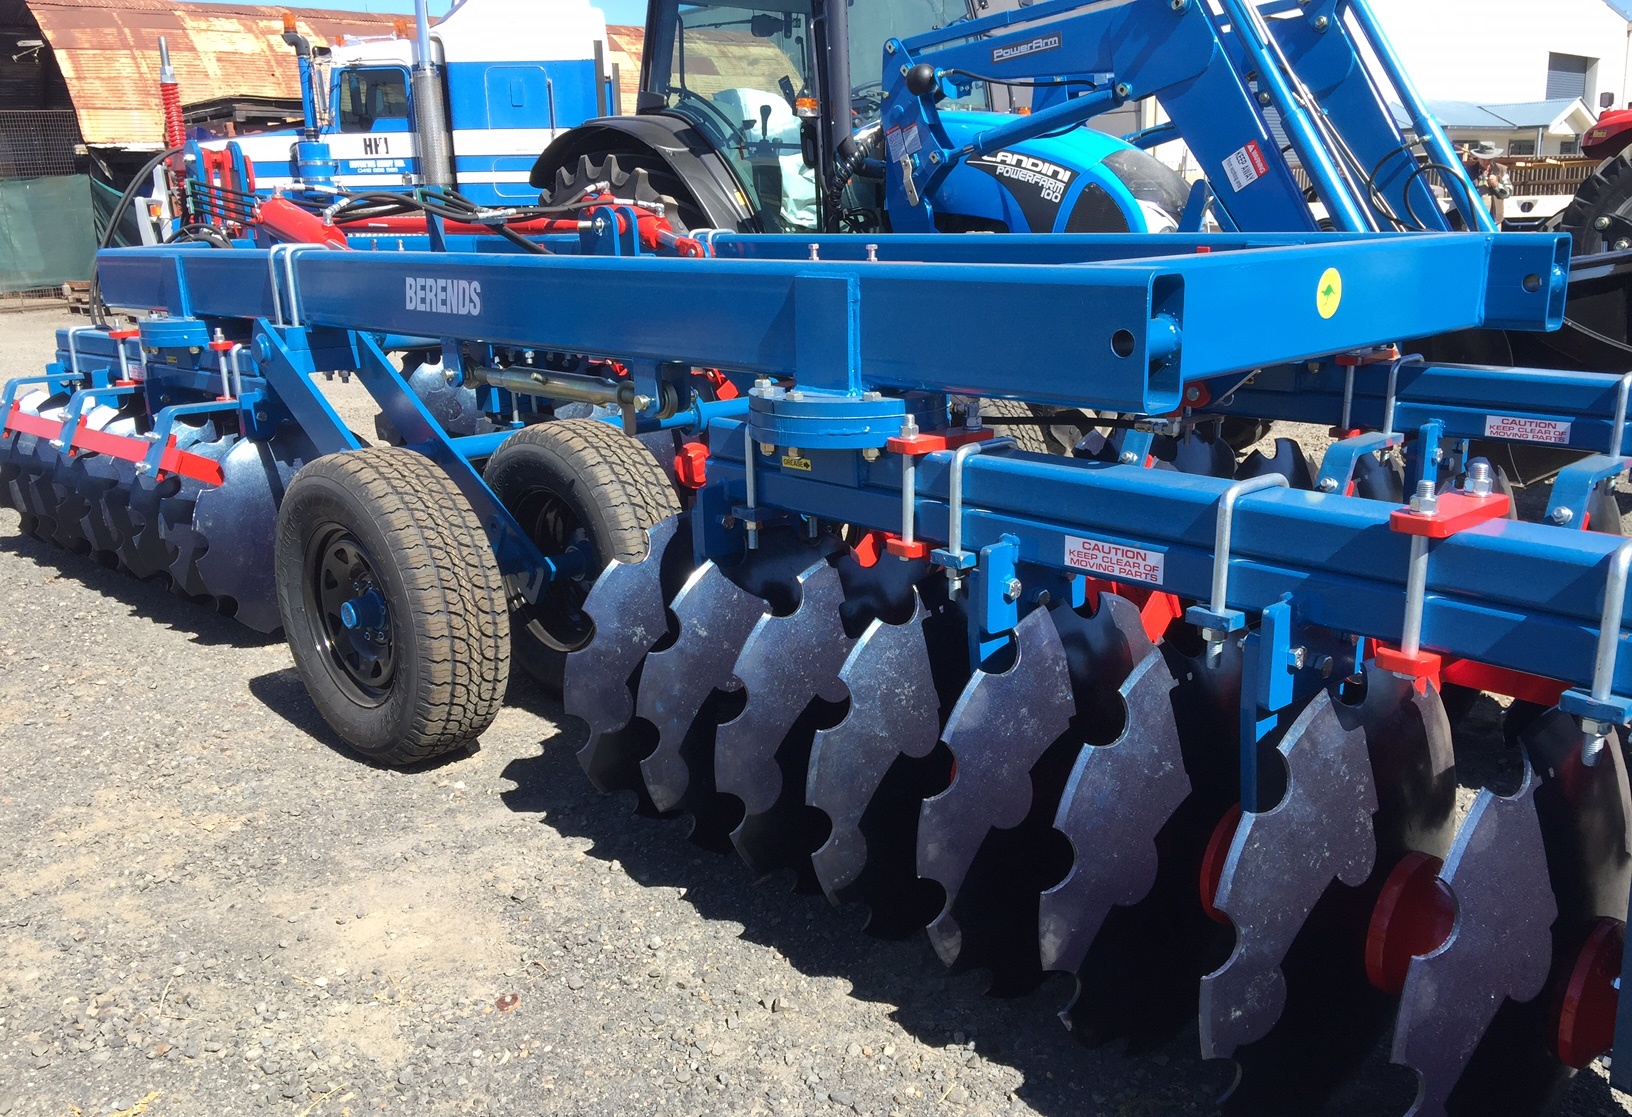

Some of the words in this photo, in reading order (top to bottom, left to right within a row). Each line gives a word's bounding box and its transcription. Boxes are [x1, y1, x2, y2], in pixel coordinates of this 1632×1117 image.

[993, 36, 1059, 60] PowerArm
[1235, 150, 1247, 165] KEEP
[1241, 165, 1255, 181] AWAY
[1251, 149, 1266, 174] WARNING
[996, 165, 1066, 194] POWERFARM
[1040, 188, 1061, 203] 100
[405, 277, 481, 316] BERENDS
[1489, 424, 1515, 432] KEEP
[1517, 427, 1551, 435] CLEAR
[1501, 418, 1557, 429] CAUTION
[1490, 430, 1528, 439] MOVING
[1532, 434, 1565, 442] PARTS
[783, 458, 804, 468] GREASE
[1068, 549, 1098, 560] KEEP
[1101, 555, 1141, 570] CLEAR
[1143, 564, 1160, 573] OF
[1082, 541, 1147, 562] CAUTION
[1069, 557, 1115, 573] MOVING
[1118, 567, 1158, 582] PARTS
